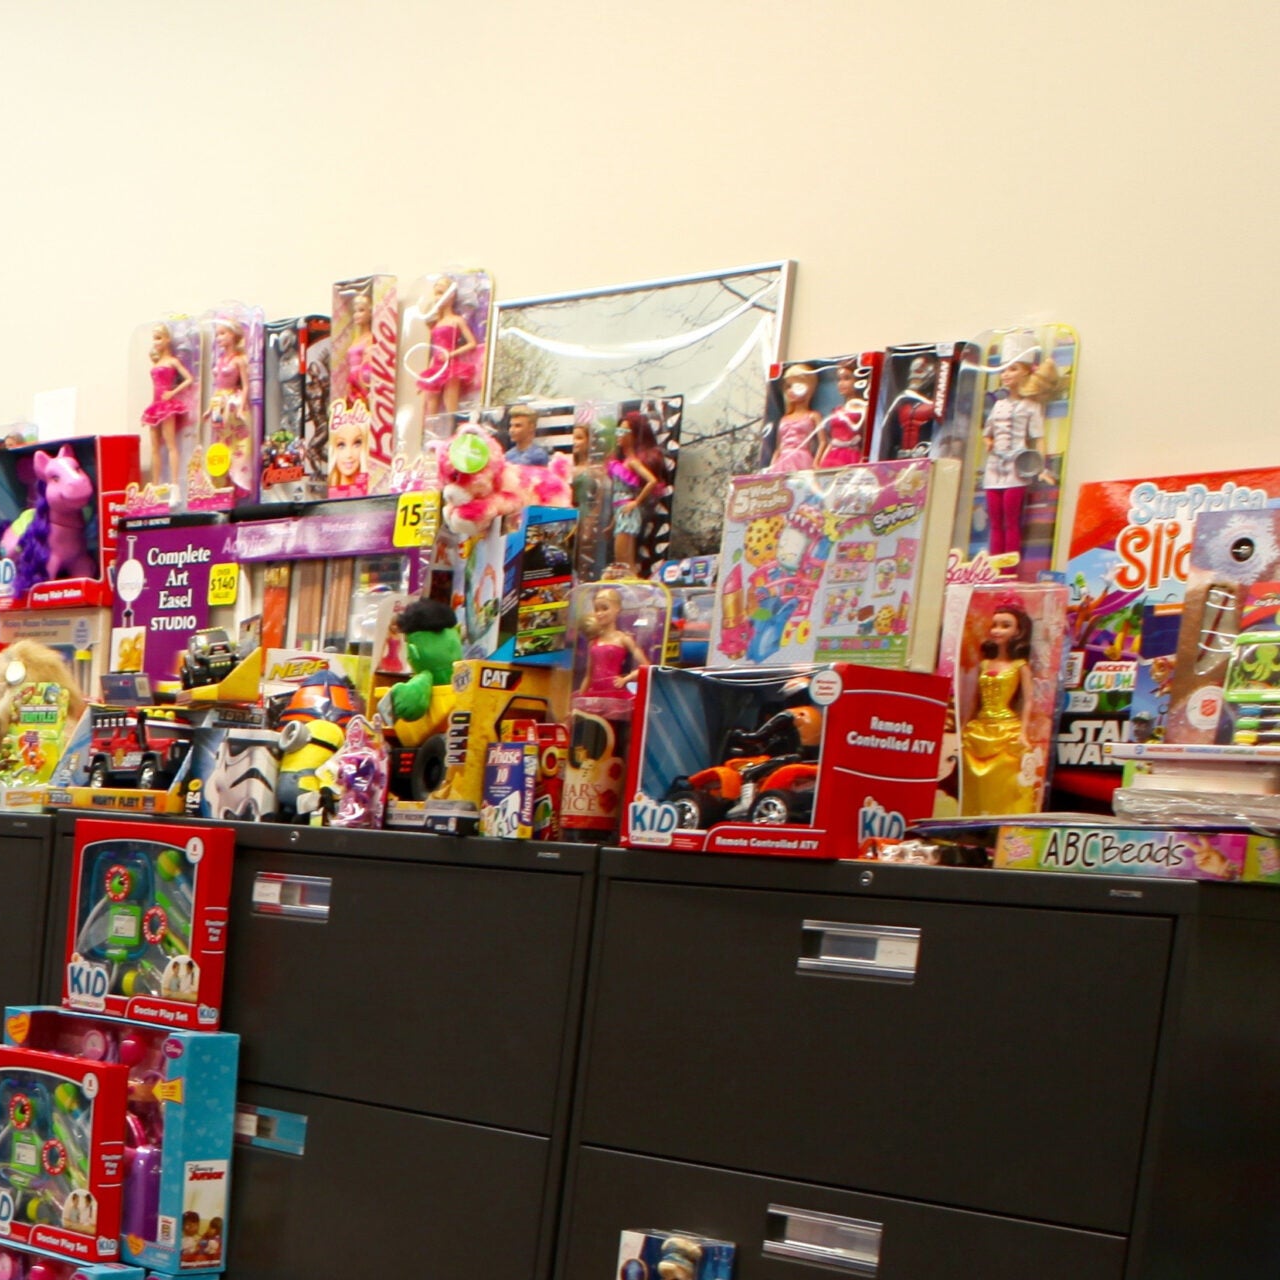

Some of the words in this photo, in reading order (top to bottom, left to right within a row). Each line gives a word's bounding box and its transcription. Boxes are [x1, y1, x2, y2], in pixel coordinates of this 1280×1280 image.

[330, 402, 369, 430] Barbie
[399, 504, 420, 527] 15
[147, 543, 211, 569] Complete
[165, 568, 189, 588] Art
[946, 555, 996, 584] Barbie
[210, 575, 236, 593] $140
[158, 589, 193, 610] Easel
[150, 614, 197, 632] STUDIO
[270, 658, 327, 682] NERF
[481, 667, 511, 689] CAT
[869, 715, 914, 735] Remote
[846, 731, 909, 752] Controlled
[911, 738, 935, 755] ATV
[487, 746, 520, 767] Phase
[495, 765, 509, 784] 10
[631, 803, 677, 834] KID
[861, 809, 905, 842] KID
[70, 964, 108, 999] KID
[133, 1004, 158, 1018] Doctor
[158, 1008, 175, 1021] Play
[175, 1011, 189, 1022] Set
[36, 1232, 59, 1246] Doctor
[59, 1237, 76, 1252] Play
